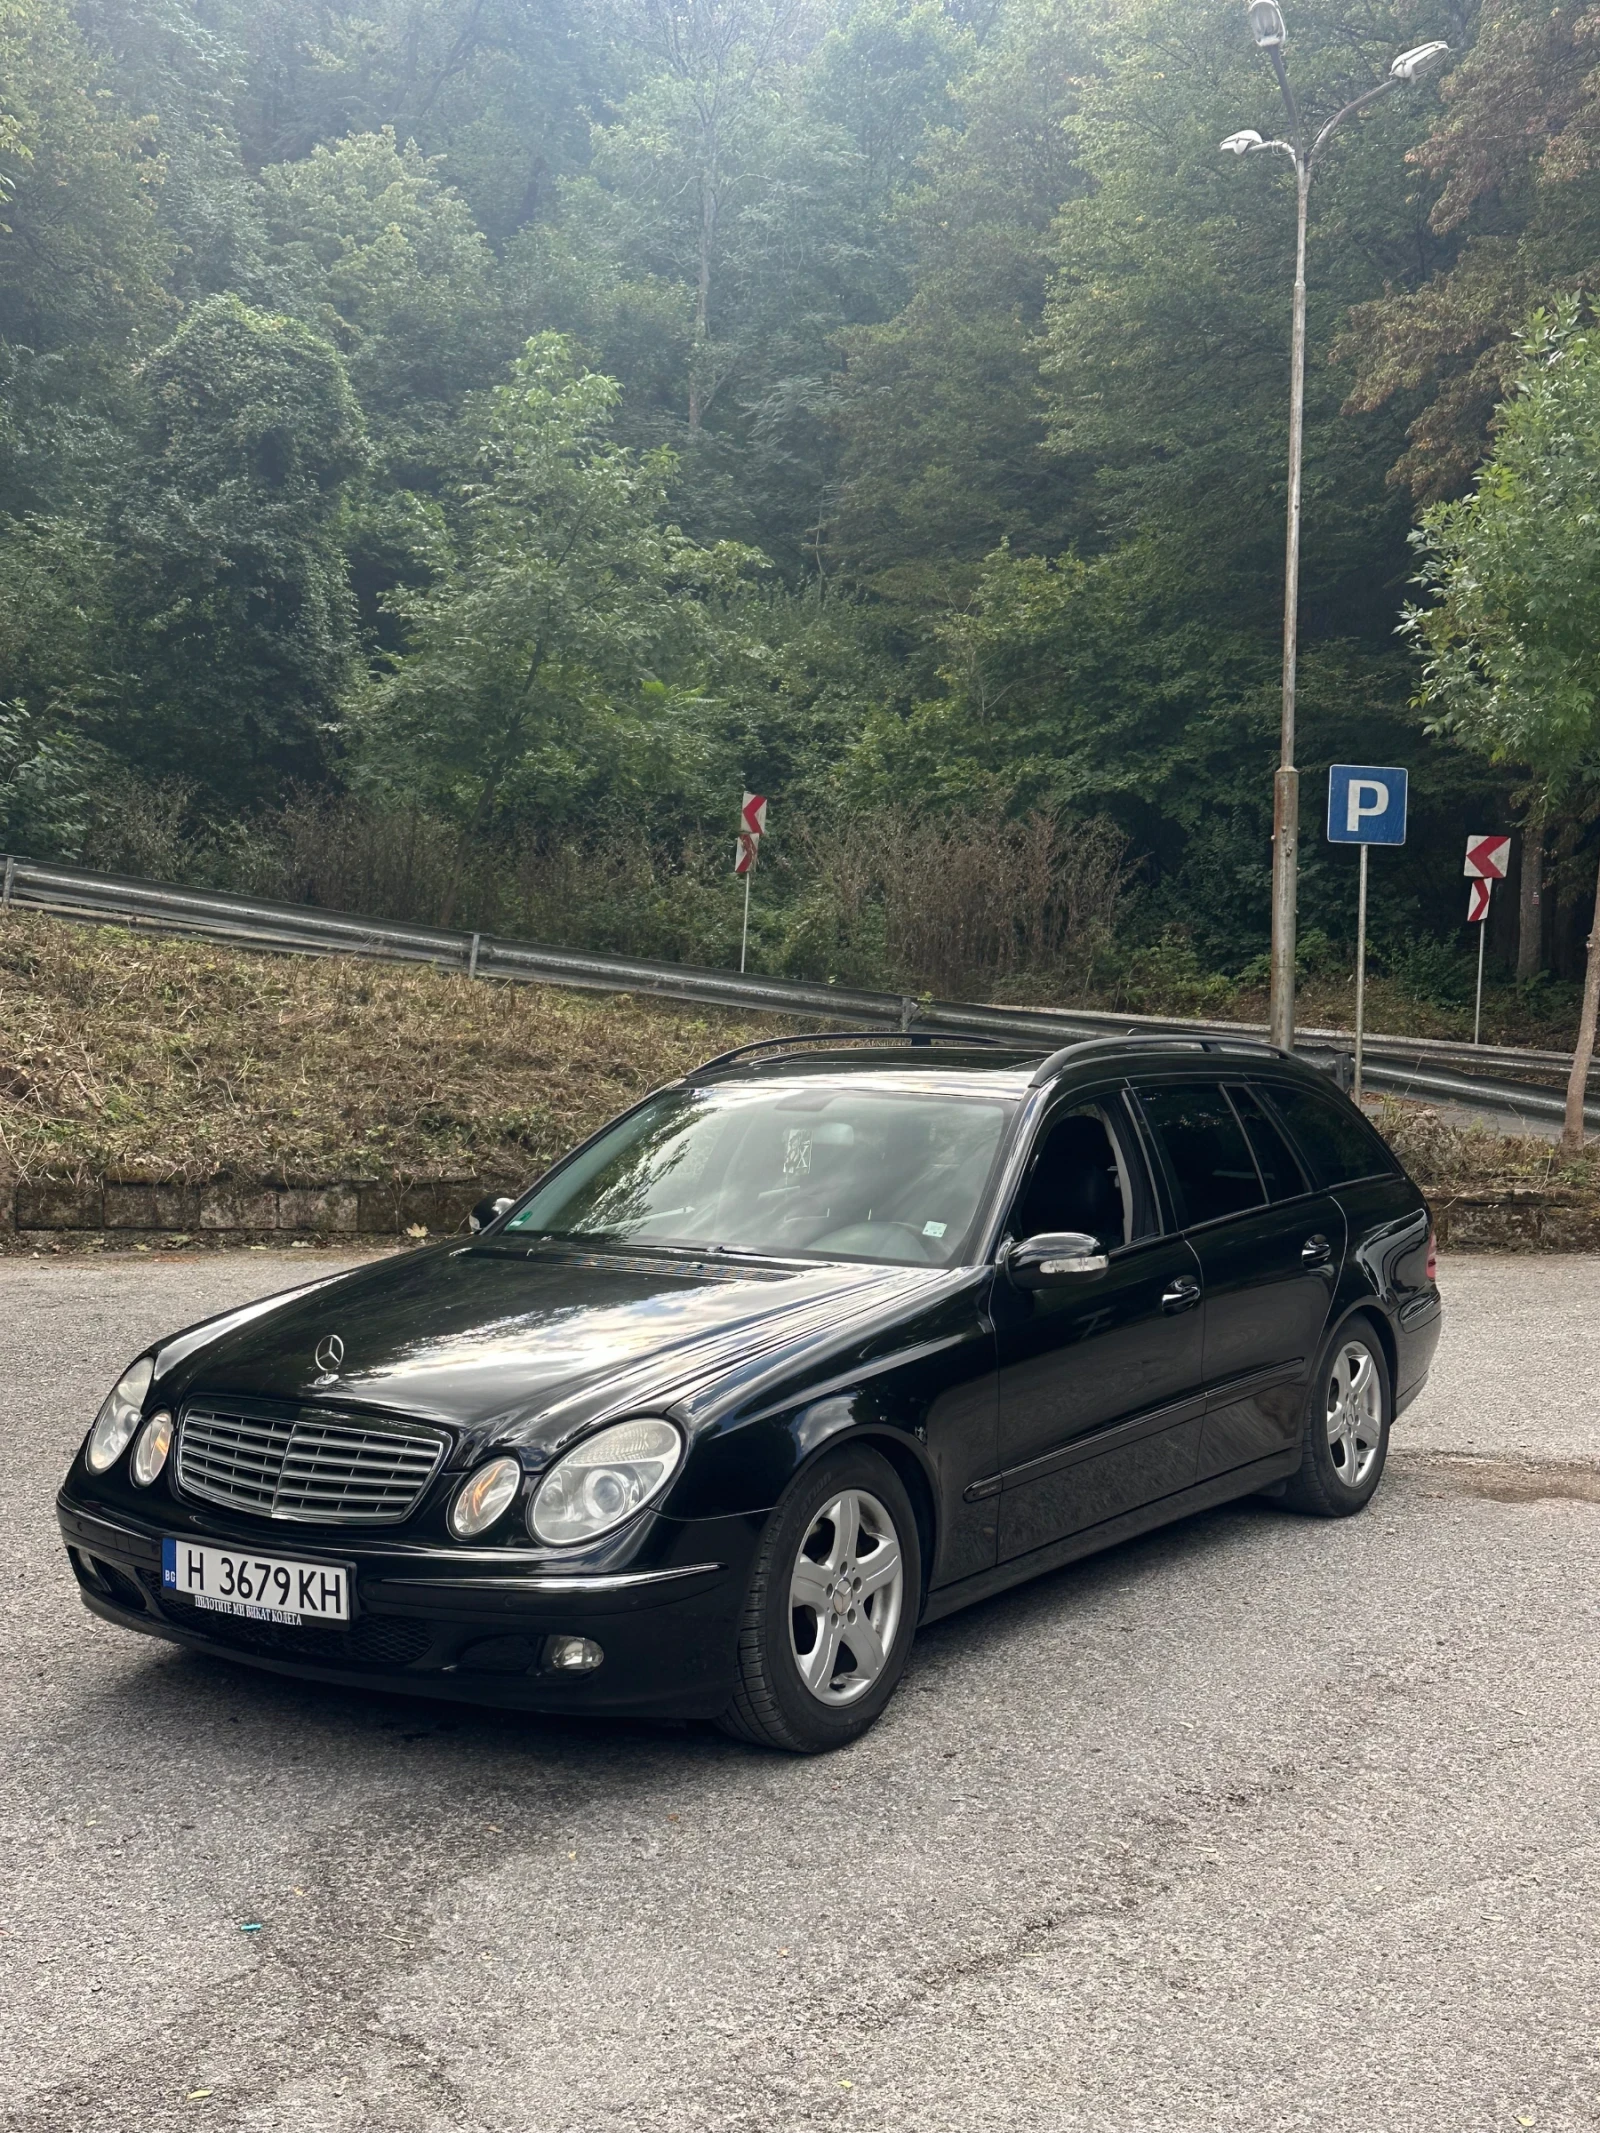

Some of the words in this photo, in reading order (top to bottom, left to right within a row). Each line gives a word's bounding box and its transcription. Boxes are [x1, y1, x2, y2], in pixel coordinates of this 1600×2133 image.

[1346, 779, 1389, 832] P
[165, 1570, 176, 1583] BG
[188, 1550, 204, 1590] H
[219, 1557, 291, 1606] 3679
[299, 1569, 341, 1614] KH
[271, 1610, 302, 1626] КОЛЕГА
